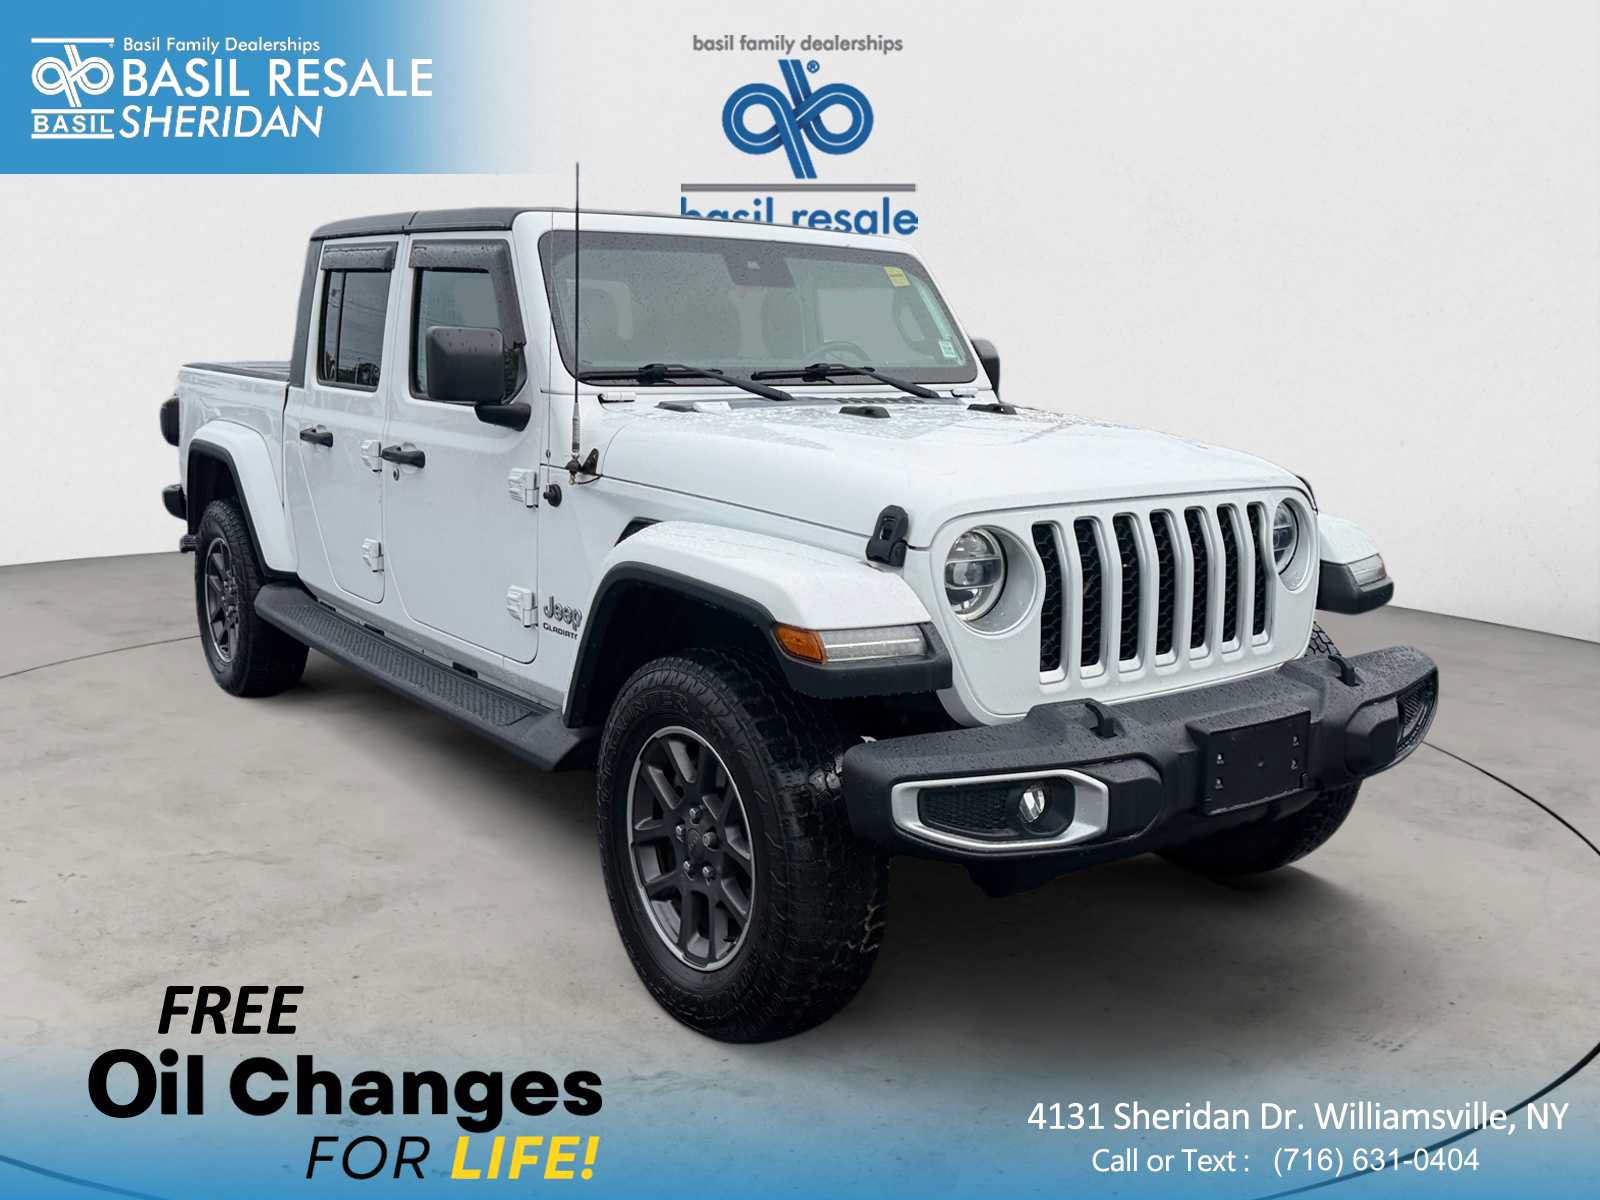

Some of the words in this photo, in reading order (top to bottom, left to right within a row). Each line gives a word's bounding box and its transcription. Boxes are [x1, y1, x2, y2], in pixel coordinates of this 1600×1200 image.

[692, 34, 735, 51] basil
[739, 34, 796, 55] family
[800, 34, 904, 55] dealerships
[792, 196, 919, 235] resale
[543, 595, 583, 631] Jeep
